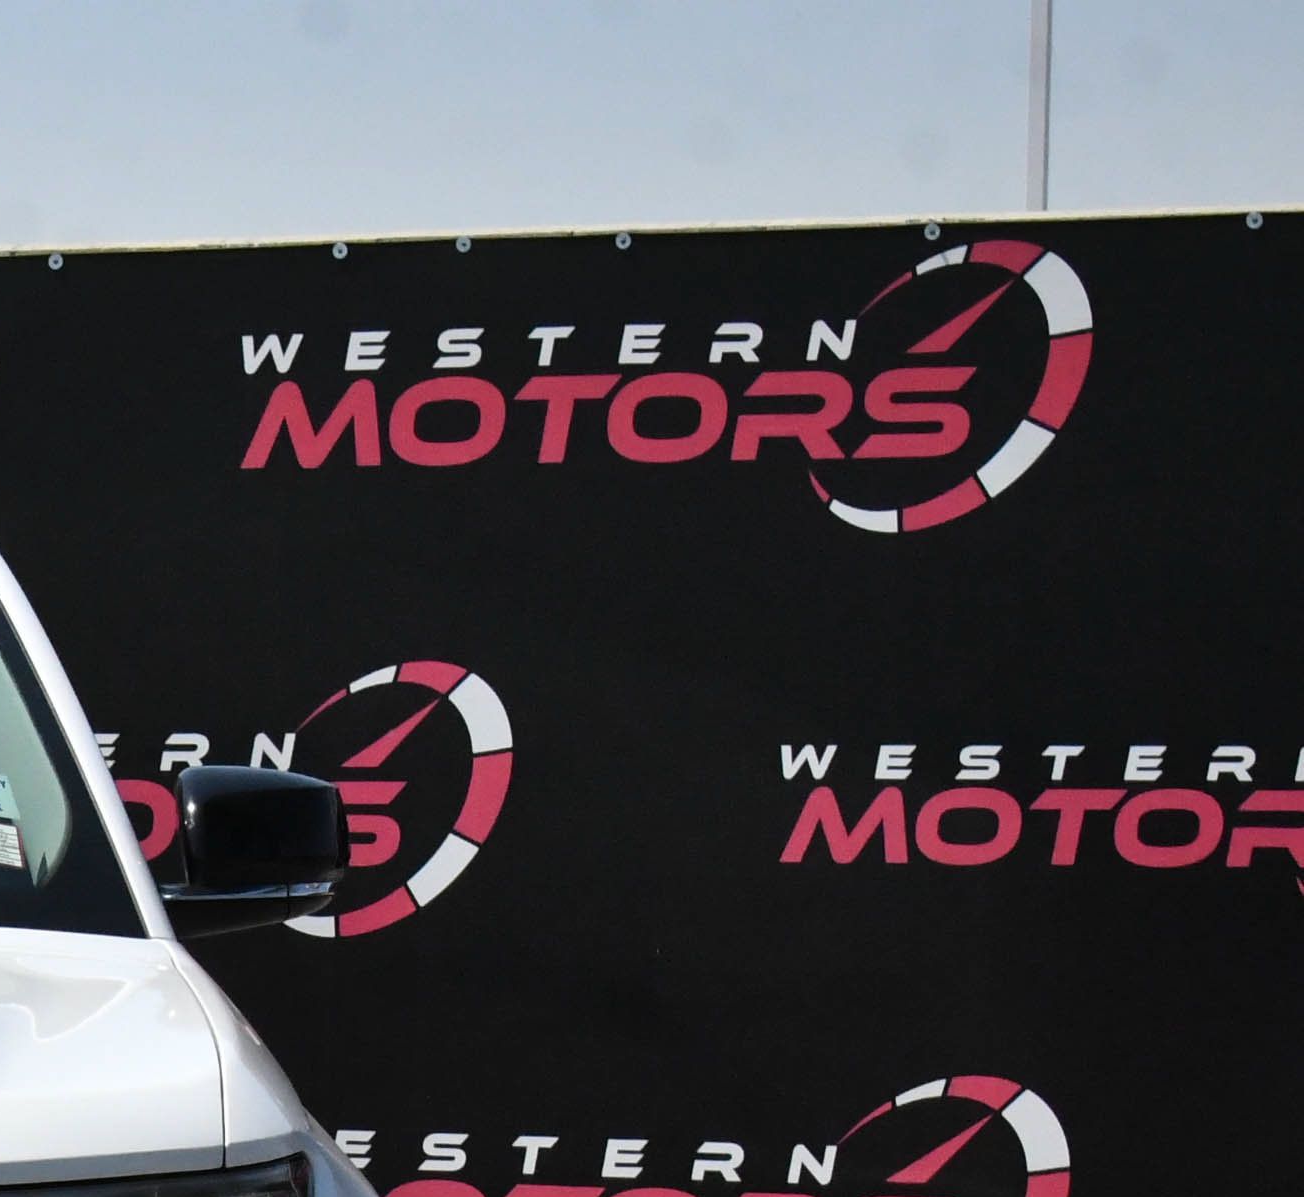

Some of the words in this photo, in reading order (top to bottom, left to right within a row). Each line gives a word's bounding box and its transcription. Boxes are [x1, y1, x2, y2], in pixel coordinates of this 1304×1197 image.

[243, 319, 857, 375] WESTERN
[240, 365, 977, 470] MOTORS
[780, 744, 1304, 782] WESTER
